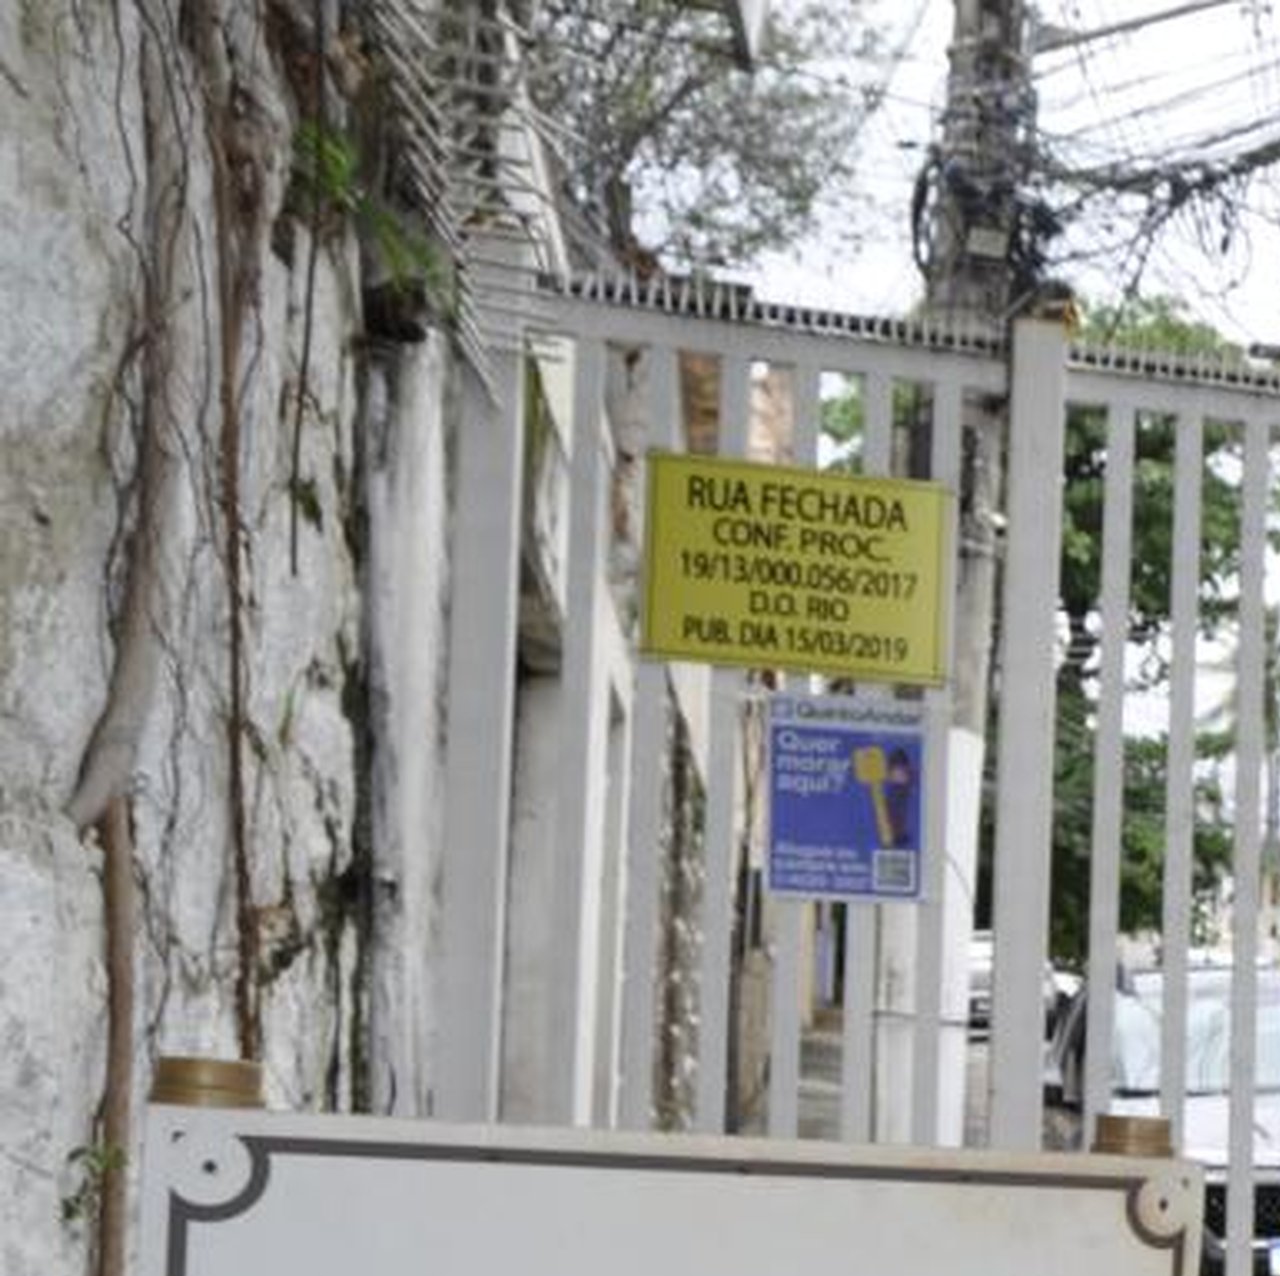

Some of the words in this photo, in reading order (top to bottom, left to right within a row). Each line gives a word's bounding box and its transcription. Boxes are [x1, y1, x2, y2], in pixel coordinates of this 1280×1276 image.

[687, 475, 751, 515] RUA
[761, 484, 908, 532] FECHADA
[713, 517, 793, 553] CONF.
[681, 550, 918, 600] 19/13/000.056/2017
[750, 590, 798, 619] D.O.
[807, 594, 849, 622] RIO
[683, 614, 733, 645] PUB.
[740, 619, 778, 648] DIA
[786, 626, 909, 662] 15/03/2019
[777, 730, 842, 753] Quer
